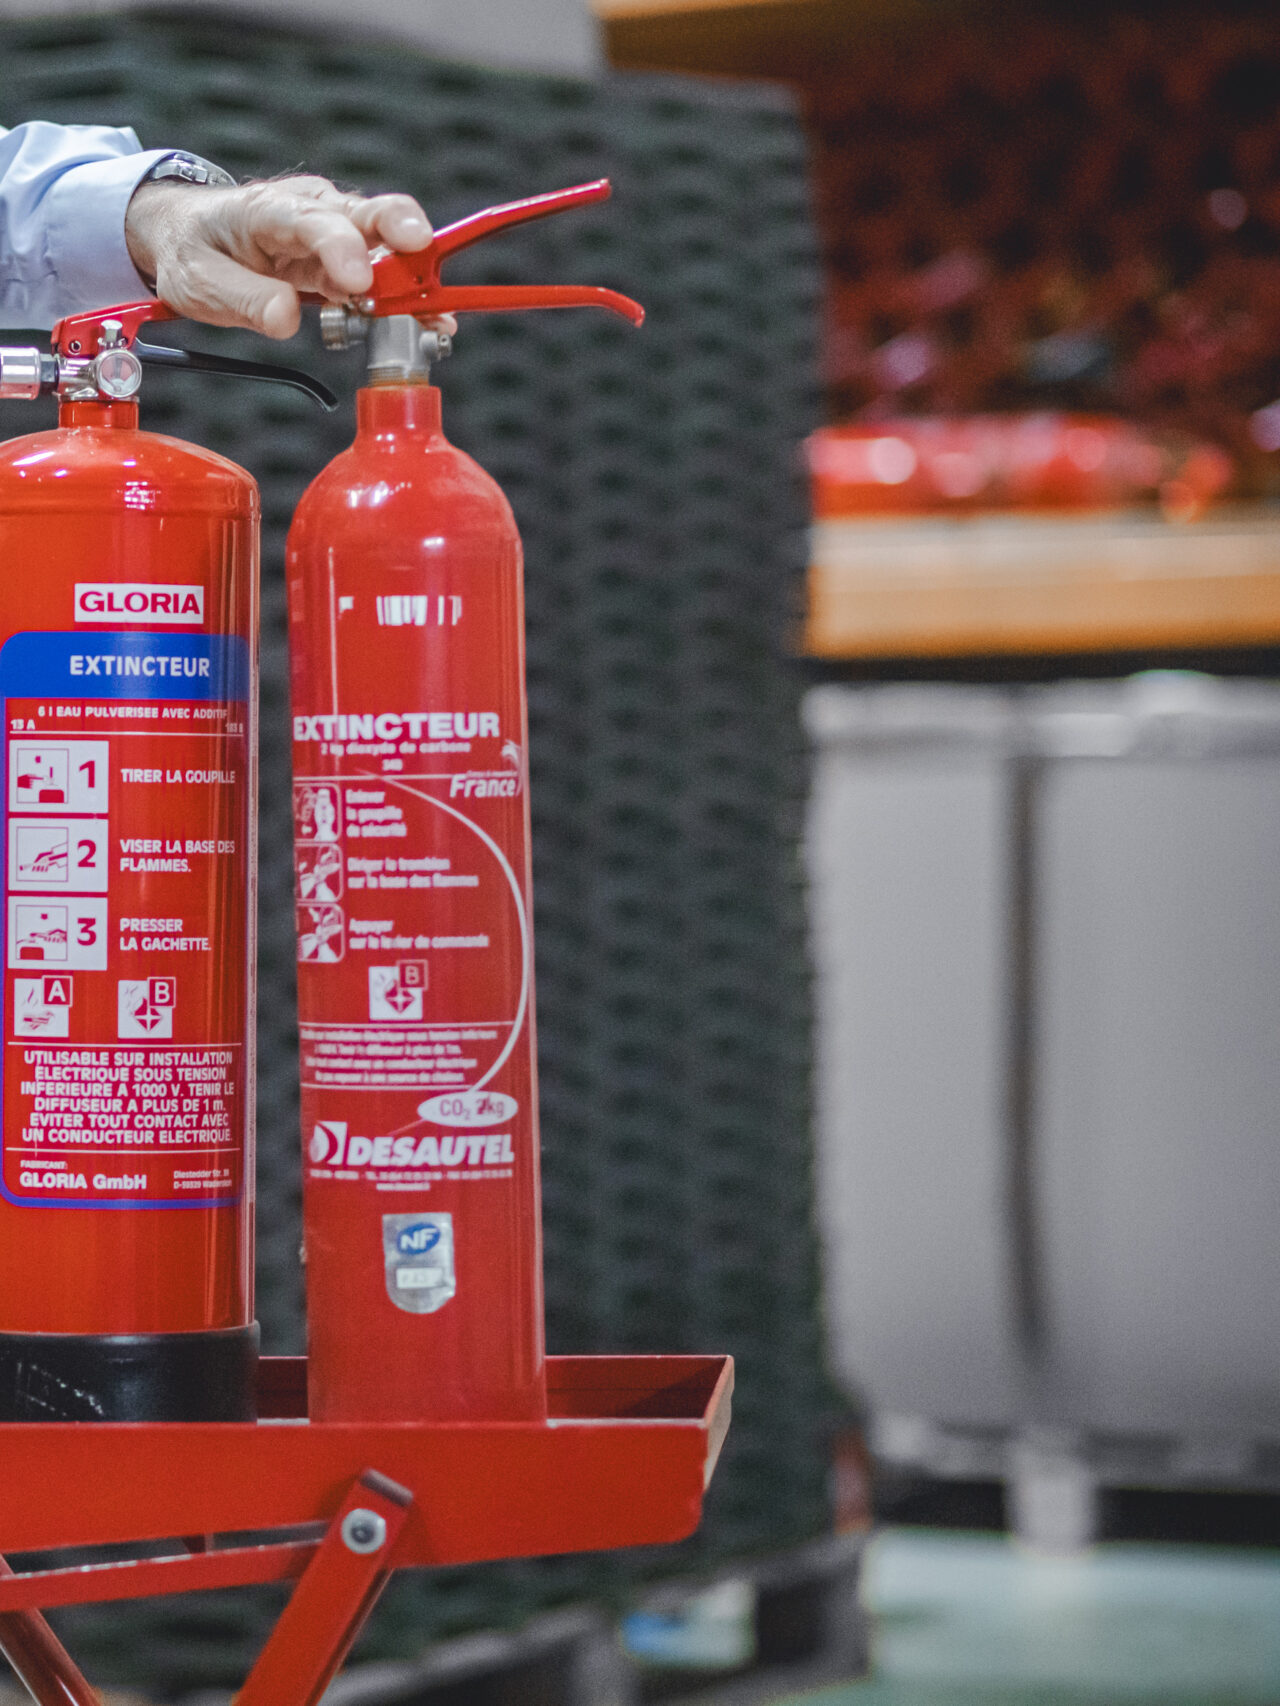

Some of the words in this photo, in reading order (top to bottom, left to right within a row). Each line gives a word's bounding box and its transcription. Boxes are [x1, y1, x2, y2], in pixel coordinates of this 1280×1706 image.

[79, 591, 200, 615] GLORIA
[70, 655, 210, 677] EXTINCTEUR
[38, 706, 46, 717] 6
[56, 706, 81, 718] EAU
[85, 707, 158, 719] PULVERISEE
[162, 707, 190, 719] AVEC
[193, 708, 228, 720] ADDITIF
[26, 719, 36, 730] A
[293, 712, 500, 741] EXTINCTEUR
[79, 760, 96, 788] 1
[120, 767, 163, 783] TIRER
[166, 769, 182, 783] LA
[185, 770, 236, 784] GOUPILLE
[449, 774, 516, 798] France
[77, 839, 97, 868] 2
[120, 839, 162, 853] VISER
[166, 840, 182, 853] LA
[185, 840, 215, 854] BASE
[217, 841, 236, 854] DES
[120, 857, 192, 872] FLAMMES.
[77, 917, 97, 946] 3
[120, 918, 183, 932] PRESSER
[120, 937, 138, 950] LA
[141, 937, 212, 951] GACHETTE.
[404, 965, 420, 985] B
[48, 980, 66, 1002] A
[154, 982, 170, 1003] B
[24, 1051, 109, 1066] UTILISABLE
[113, 1052, 145, 1066] SUR
[149, 1052, 233, 1066] INSTALLATION
[35, 1066, 129, 1083] ELECTRIQUE
[133, 1068, 173, 1082] SOUS
[177, 1067, 226, 1081] TENSION
[21, 1081, 113, 1097] INFERIEURE
[132, 1083, 167, 1097] 1000
[171, 1083, 184, 1097] V.
[188, 1082, 222, 1096] TENIR
[224, 1082, 235, 1095] LE
[34, 1097, 122, 1112] DIFFUSEUR
[142, 1099, 179, 1112] PLUS
[182, 1099, 199, 1112] DE
[203, 1099, 210, 1112] 1
[212, 1100, 226, 1112] m.
[30, 1112, 84, 1127] EVITER
[88, 1114, 130, 1128] TOUT
[134, 1114, 198, 1128] CONTACT
[201, 1113, 229, 1127] AVEC
[22, 1128, 44, 1142] UN
[48, 1129, 154, 1144] CONDUCTEUR
[159, 1129, 233, 1144] ELECTRIQUE.
[347, 1134, 515, 1166] DESAUTEL
[20, 1172, 88, 1189] GLORIA
[93, 1174, 147, 1190] GmbH
[400, 1228, 438, 1250] NF
